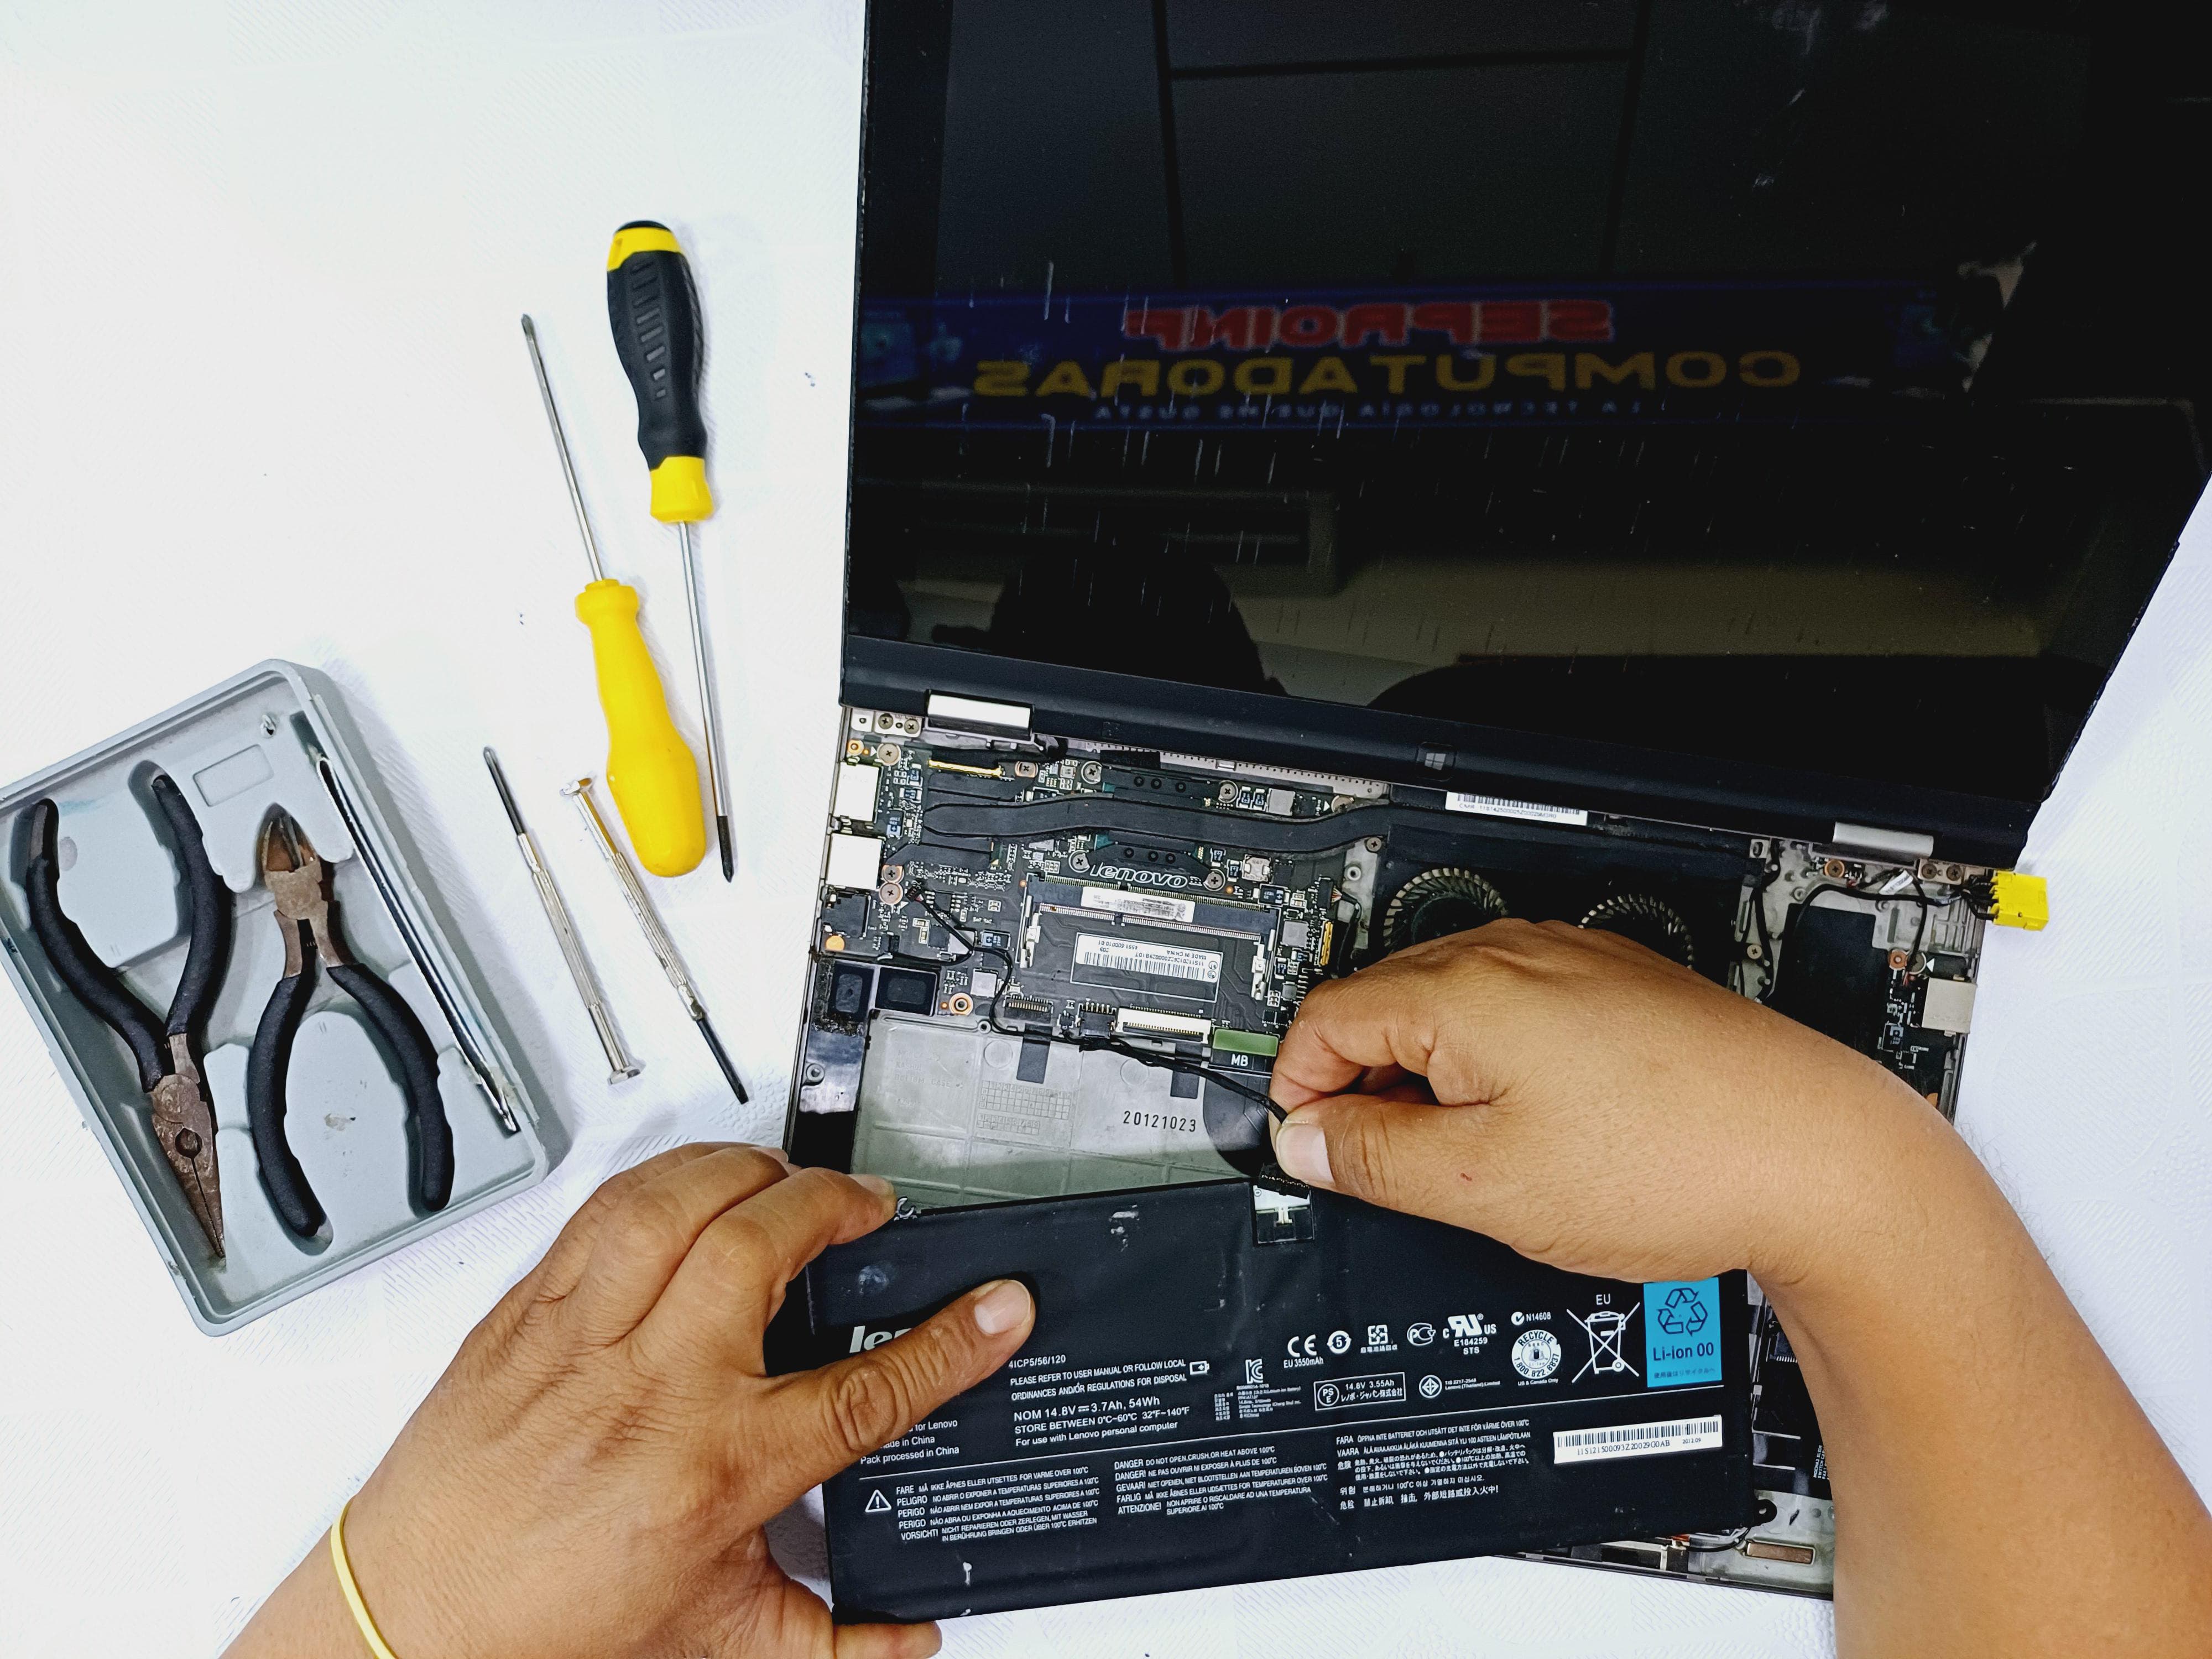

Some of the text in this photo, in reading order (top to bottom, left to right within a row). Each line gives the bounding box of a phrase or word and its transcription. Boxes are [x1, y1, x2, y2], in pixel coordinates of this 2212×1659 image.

[1090, 862, 1188, 888] lenovo
[1231, 1054, 1249, 1067] MB
[1123, 1110, 1197, 1133] 20121023
[1597, 1293, 1610, 1305] EU
[1519, 1329, 1554, 1347] RECYCLE
[1464, 1347, 1479, 1355] STS
[1653, 1342, 1714, 1361] Li-ion 00
[1284, 1357, 1323, 1368] EU 3550mAh
[1010, 1376, 1037, 1385] PLEASE
[1039, 1373, 1061, 1383] REFER
[1073, 1369, 1092, 1379] USER
[1094, 1366, 1121, 1376] MANUAL
[1135, 1361, 1162, 1371] FOLLOW
[1164, 1359, 1186, 1368] LOCAL
[1011, 1389, 1056, 1401] ORDINANCES
[1087, 1379, 1135, 1391] REGULATIONS
[1137, 1377, 1151, 1386] FOR
[1154, 1374, 1187, 1384] DISPOSAL
[1345, 1380, 1394, 1390] 14.8V 3.55Ah
[1014, 1410, 1041, 1421] NOM
[1129, 1396, 1160, 1408] 54Wh
[928, 1420, 957, 1430] Lenovo
[1015, 1423, 1047, 1434] STORE
[1050, 1417, 1095, 1430] BETWEEN
[1050, 1433, 1066, 1442] with
[1069, 1431, 1099, 1440] Lenovo
[1102, 1425, 1137, 1438] personal
[1139, 1422, 1177, 1432] computer
[911, 1436, 935, 1445] China
[1337, 1436, 1354, 1444] FARA
[860, 1455, 880, 1464] Pack
[883, 1449, 924, 1464] processed
[936, 1447, 959, 1455] China
[1337, 1448, 1359, 1457] VAARA
[1114, 1459, 1143, 1470] DANGER
[1201, 1462, 1229, 1470] EXPOSER
[896, 1485, 914, 1494] FARE
[987, 1475, 1018, 1484] UTSETTES
[1034, 1470, 1053, 1479] VARME
[897, 1495, 927, 1506] PELIGRO
[998, 1484, 1041, 1494] TEMPERATURAS
[1044, 1479, 1079, 1489] SUPERIORES
[1117, 1493, 1141, 1503] FARLIG
[898, 1507, 925, 1517] PERIGO
[999, 1495, 1043, 1506] TEMPERATURAS
[1045, 1491, 1081, 1500] SUPERIORES
[1063, 1510, 1088, 1519] WASSER
[899, 1519, 926, 1529] PERIGO
